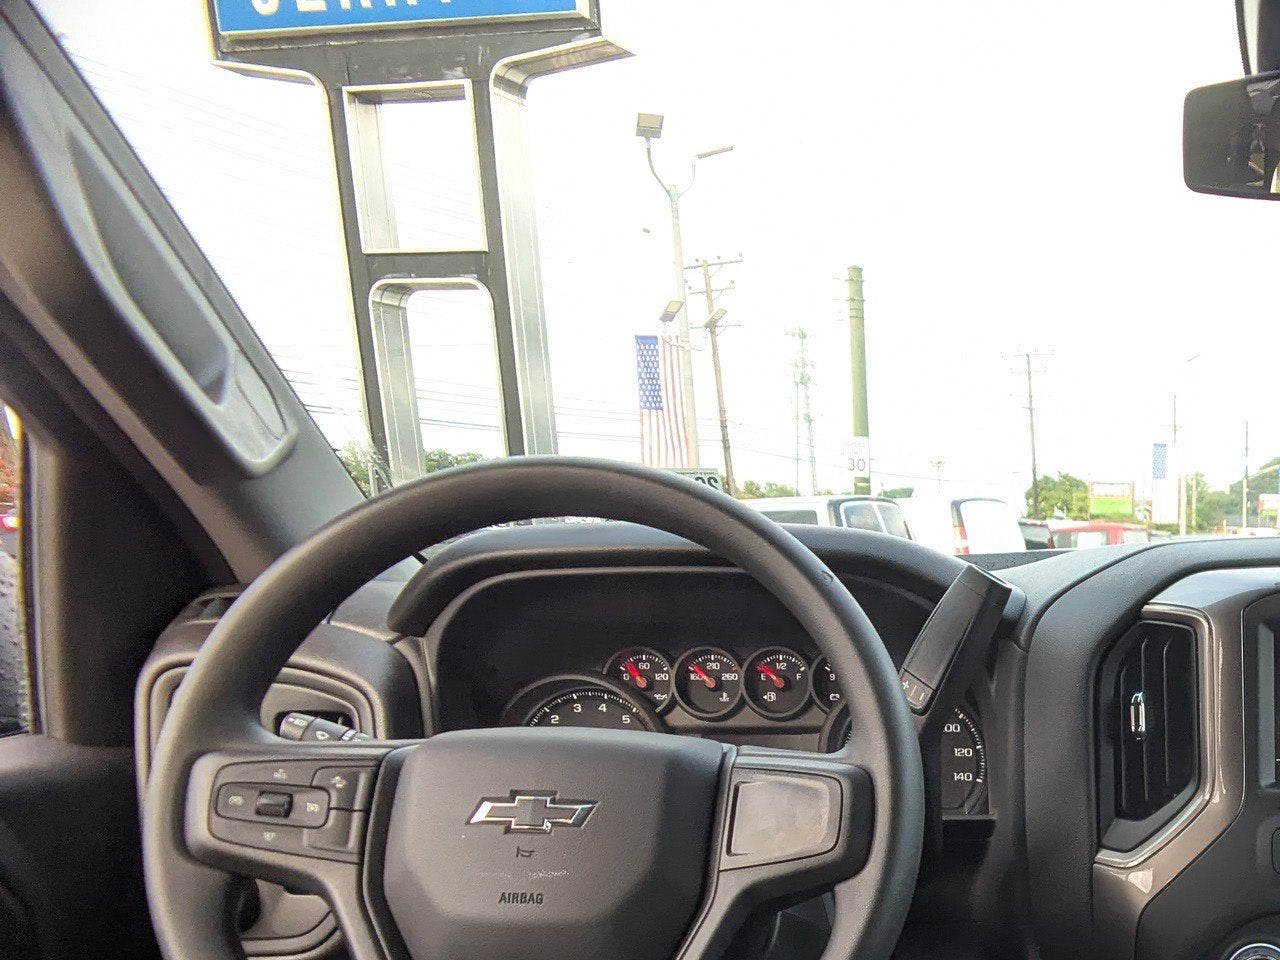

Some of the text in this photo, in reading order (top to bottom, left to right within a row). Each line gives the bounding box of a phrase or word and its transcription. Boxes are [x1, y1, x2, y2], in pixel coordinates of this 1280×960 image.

[847, 457, 866, 471] 30
[638, 662, 650, 670] 60
[706, 662, 720, 670] 210
[776, 662, 787, 670] 1/2
[623, 673, 630, 681] 0
[654, 673, 669, 681] 120
[721, 673, 738, 681] 260
[760, 673, 767, 681] E
[796, 673, 802, 681] F
[573, 703, 582, 713] 3
[598, 703, 607, 713] 4
[550, 714, 559, 724] 2
[622, 714, 631, 724] 5
[943, 723, 961, 733] 00
[953, 747, 973, 757] 120
[953, 772, 973, 782] 140
[499, 892, 544, 905] AIRBAG
